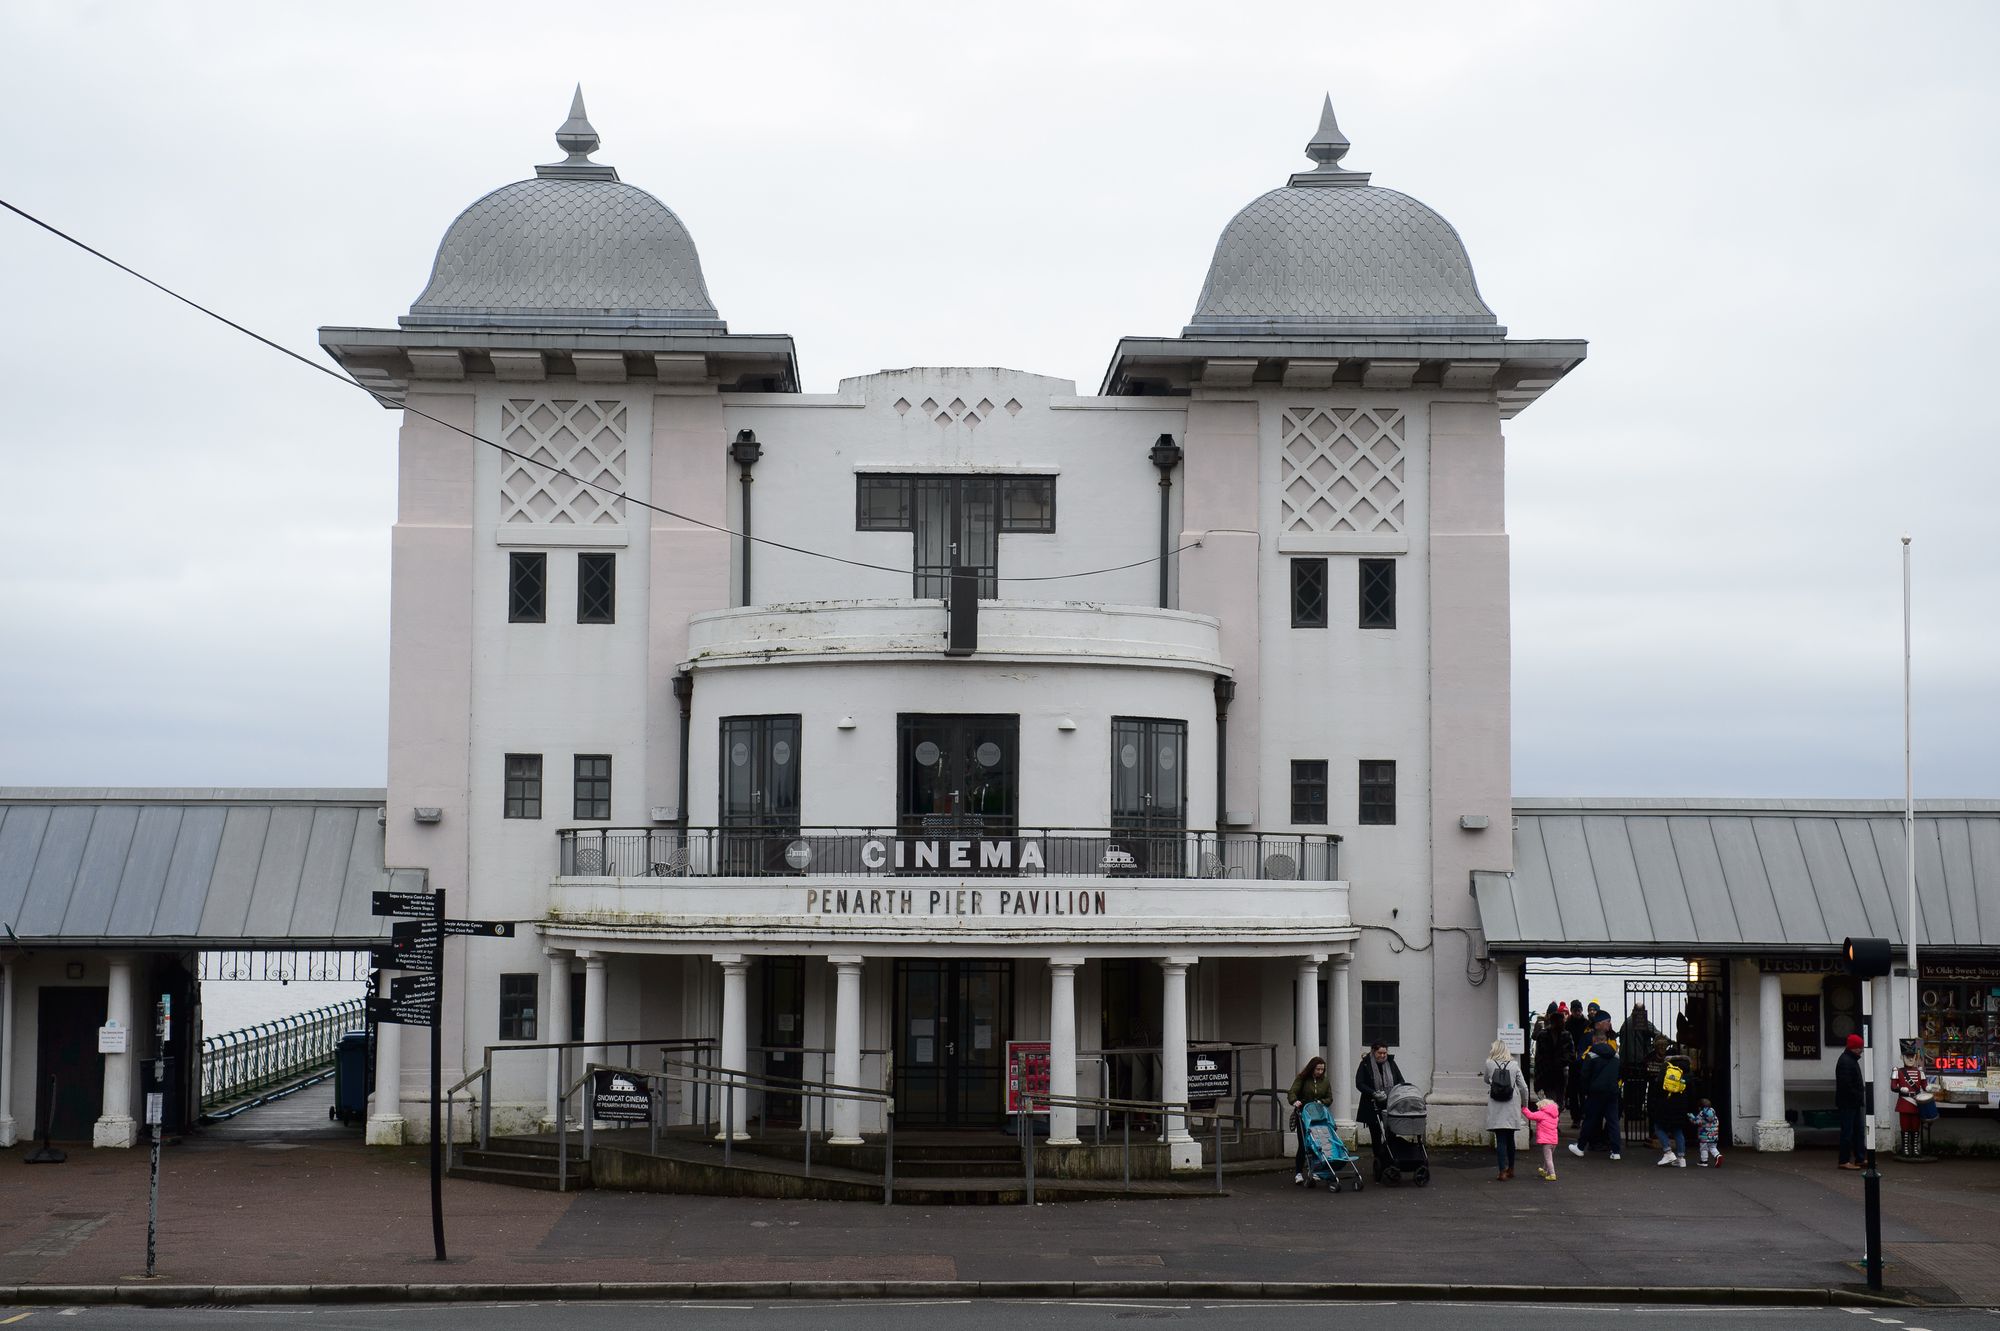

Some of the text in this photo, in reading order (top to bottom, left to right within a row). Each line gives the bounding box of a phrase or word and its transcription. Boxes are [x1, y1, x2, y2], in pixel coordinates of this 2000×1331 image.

[861, 840, 1045, 868] CINEMA
[806, 889, 1107, 915] PENARTH PIER PAVILION
[1955, 966, 1976, 974] Sweet
[1936, 1057, 1978, 1069] OPEN
